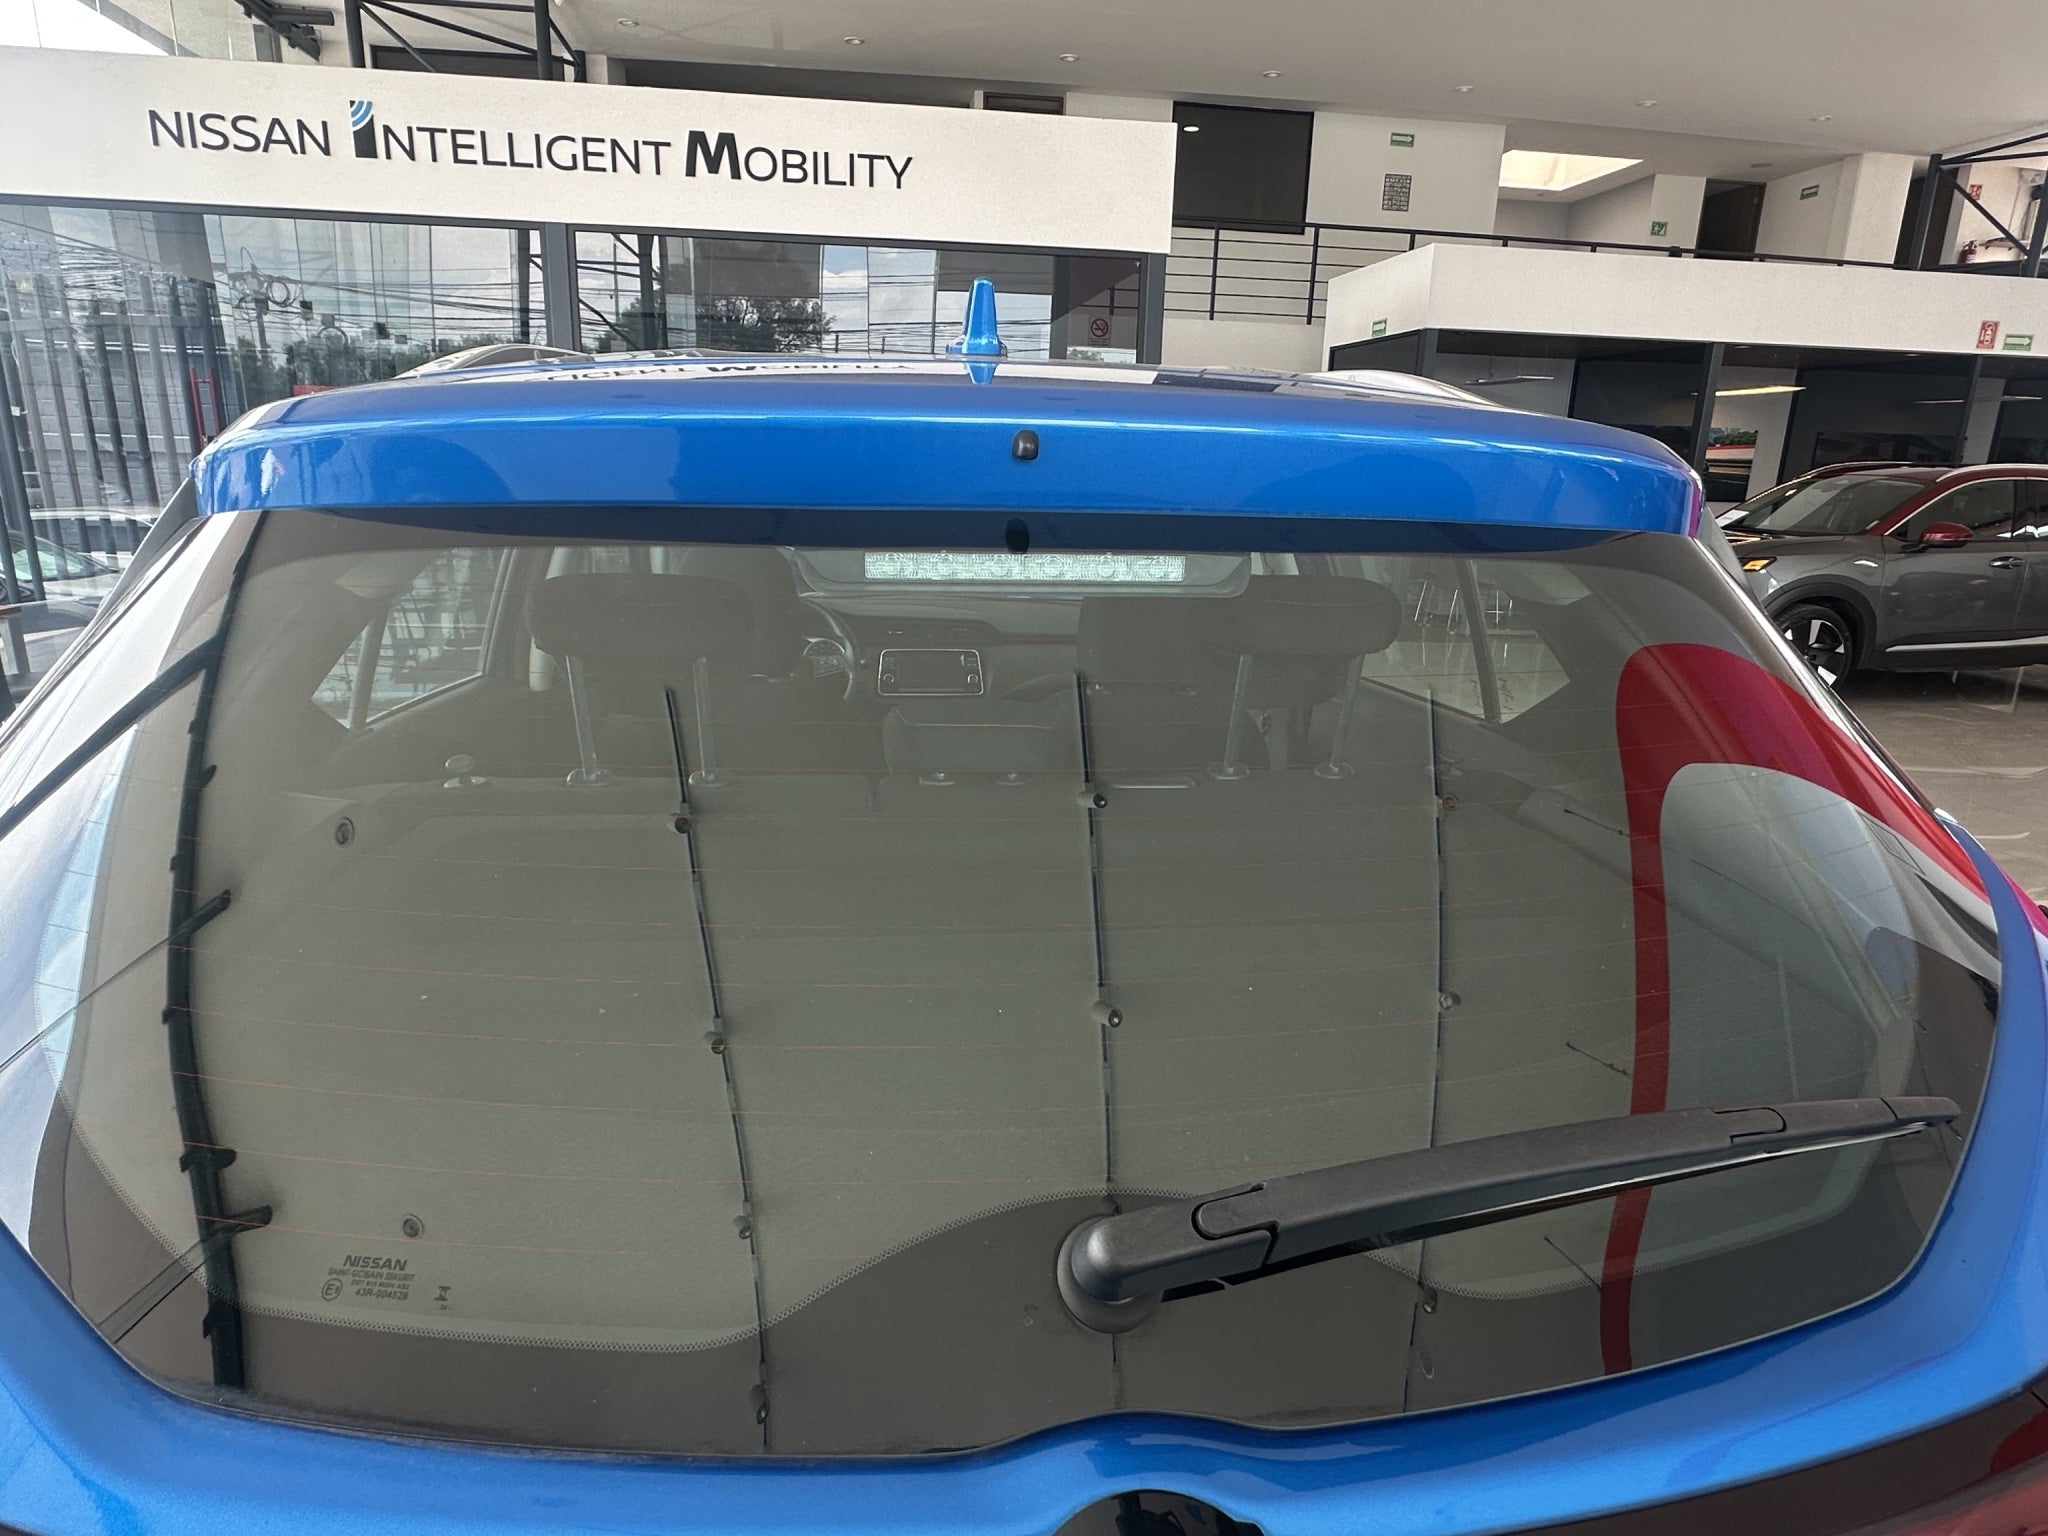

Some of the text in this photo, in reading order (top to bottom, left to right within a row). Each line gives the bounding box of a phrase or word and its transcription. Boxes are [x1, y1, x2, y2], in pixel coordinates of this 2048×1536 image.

[148, 99, 914, 190] NISSAN INTELLIGENT MOBILITY
[344, 1255, 408, 1271] NISSAN
